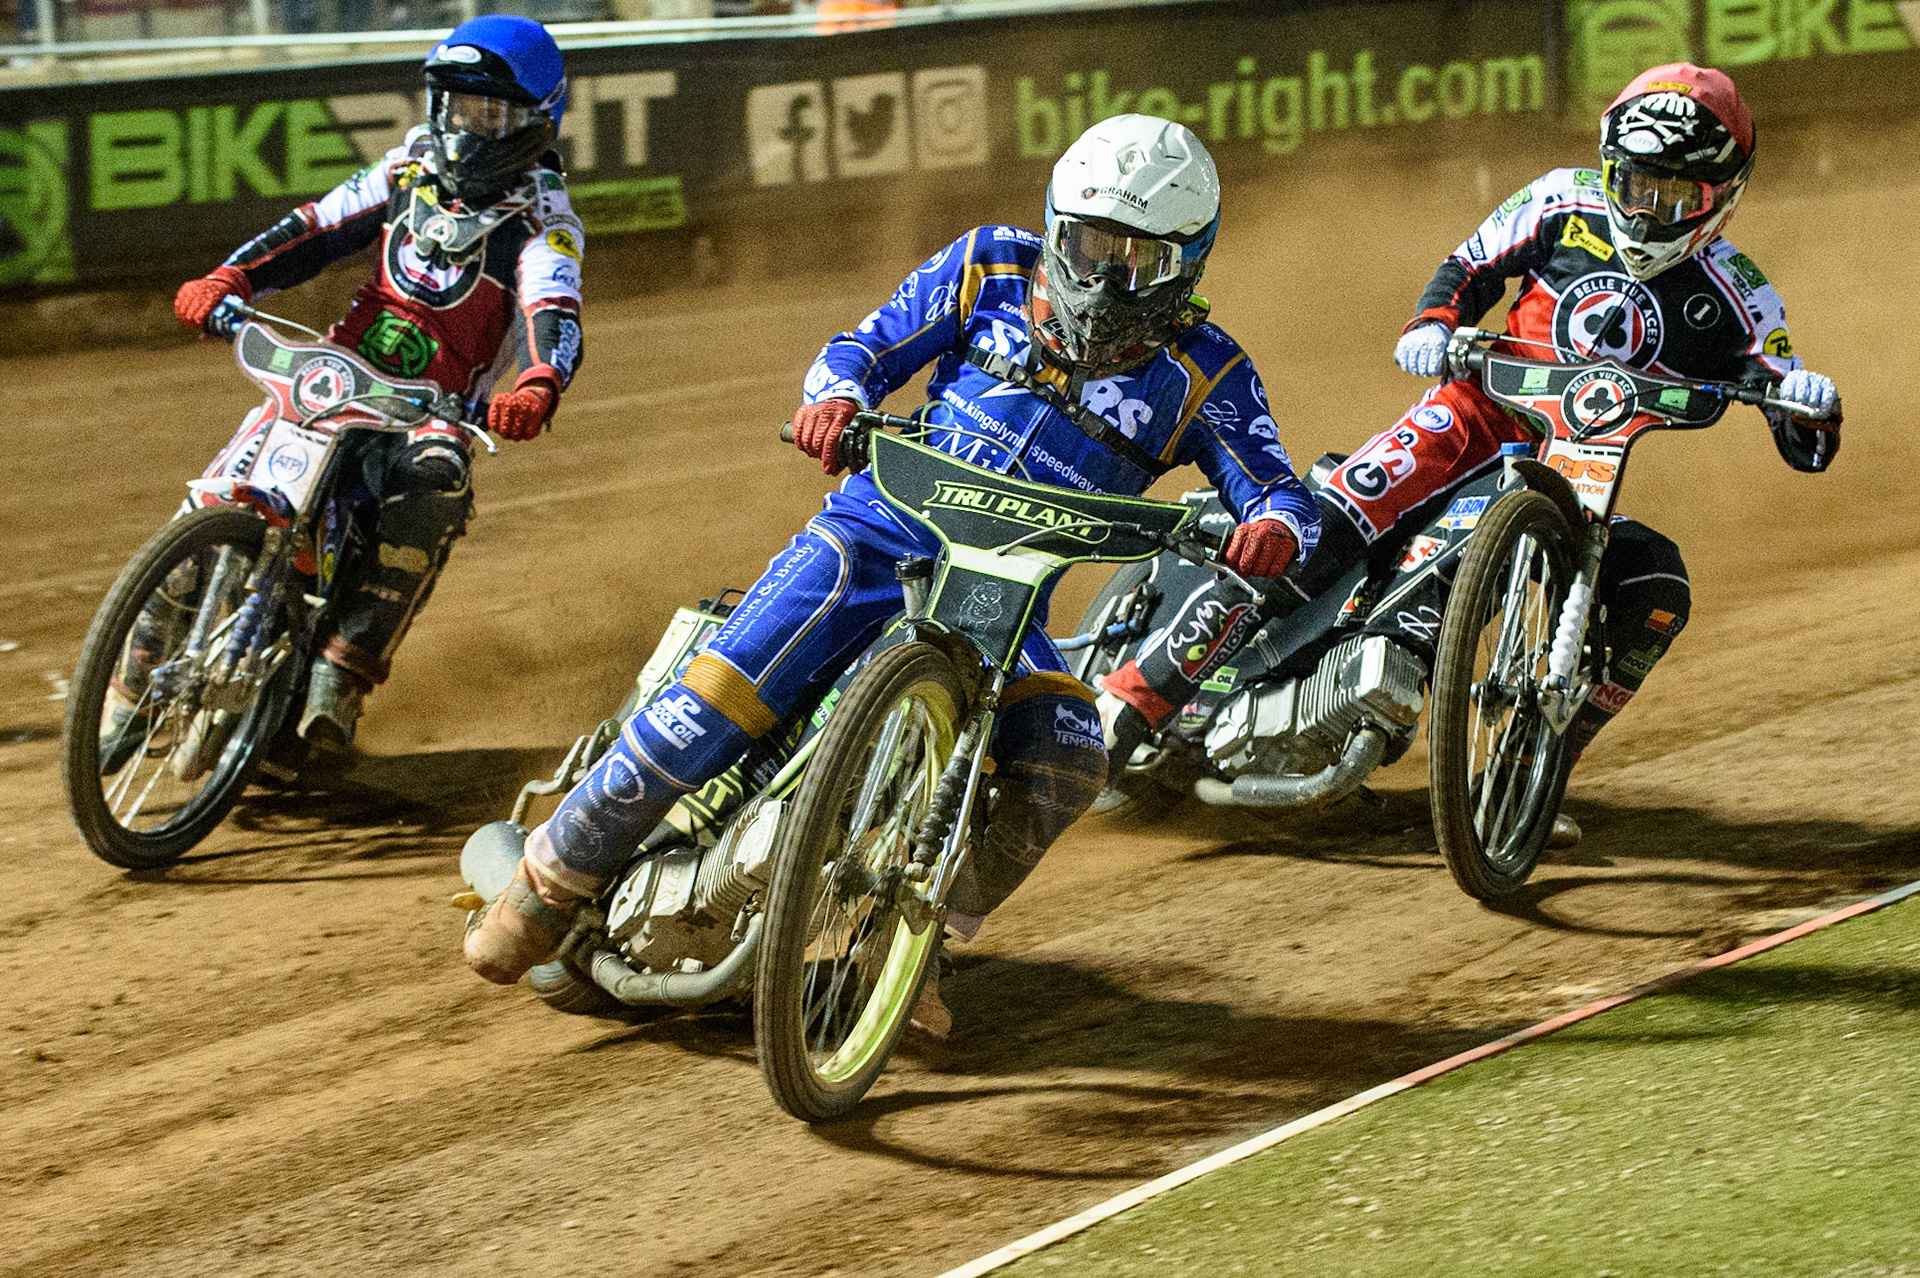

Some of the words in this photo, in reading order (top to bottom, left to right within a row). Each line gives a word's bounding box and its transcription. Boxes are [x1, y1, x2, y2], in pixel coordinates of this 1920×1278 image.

[1705, 0, 1918, 66] BIKE
[1101, 186, 1148, 209] GRAHAM
[1469, 235, 1486, 261] ARD
[1573, 278, 1615, 300] BELLE
[1621, 281, 1647, 304] VUE
[1642, 308, 1658, 346] ACES
[1568, 371, 1596, 395] BELLE
[1599, 371, 1619, 383] VUE
[1617, 380, 1635, 397] ACE
[1571, 481, 1606, 496] ATION
[939, 486, 997, 509] TRU
[994, 496, 1094, 537] PLANT
[715, 599, 762, 646] Minors
[757, 581, 779, 597] &
[774, 542, 815, 579] Brady
[674, 723, 698, 744] OIL
